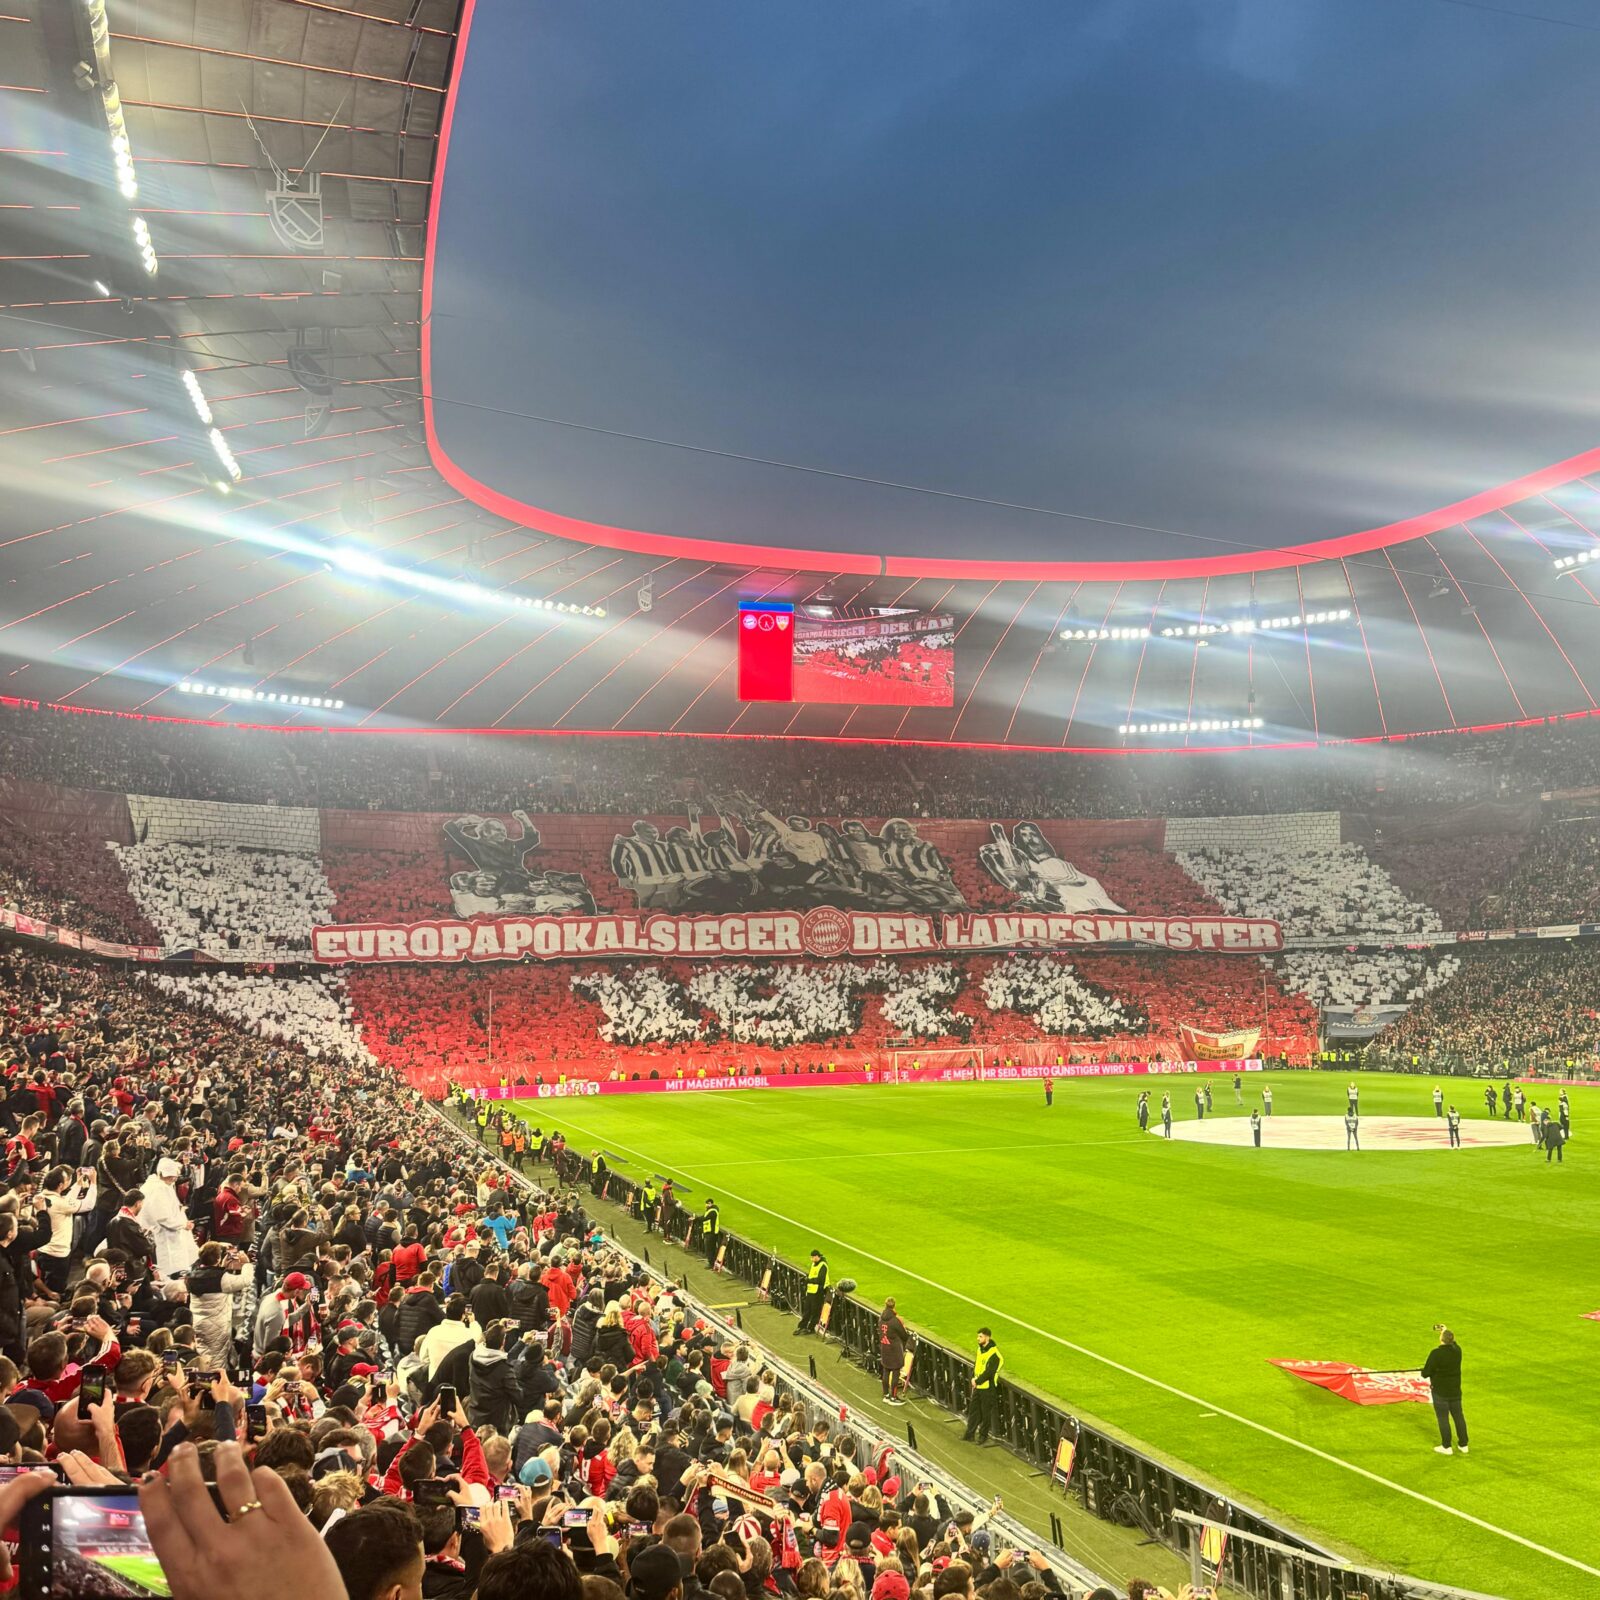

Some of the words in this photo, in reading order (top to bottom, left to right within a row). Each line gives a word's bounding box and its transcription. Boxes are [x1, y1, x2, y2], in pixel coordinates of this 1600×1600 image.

[817, 912, 846, 929] BAYERN
[316, 916, 801, 957] EUROPAPOKALSIEGER
[852, 916, 935, 951] DER
[946, 917, 1279, 949] LANDESMEISTER
[1020, 1066, 1050, 1077] DESTO
[666, 1080, 684, 1090] MIT
[686, 1077, 737, 1089] MAGENTA
[738, 1076, 770, 1087] MOBIL
